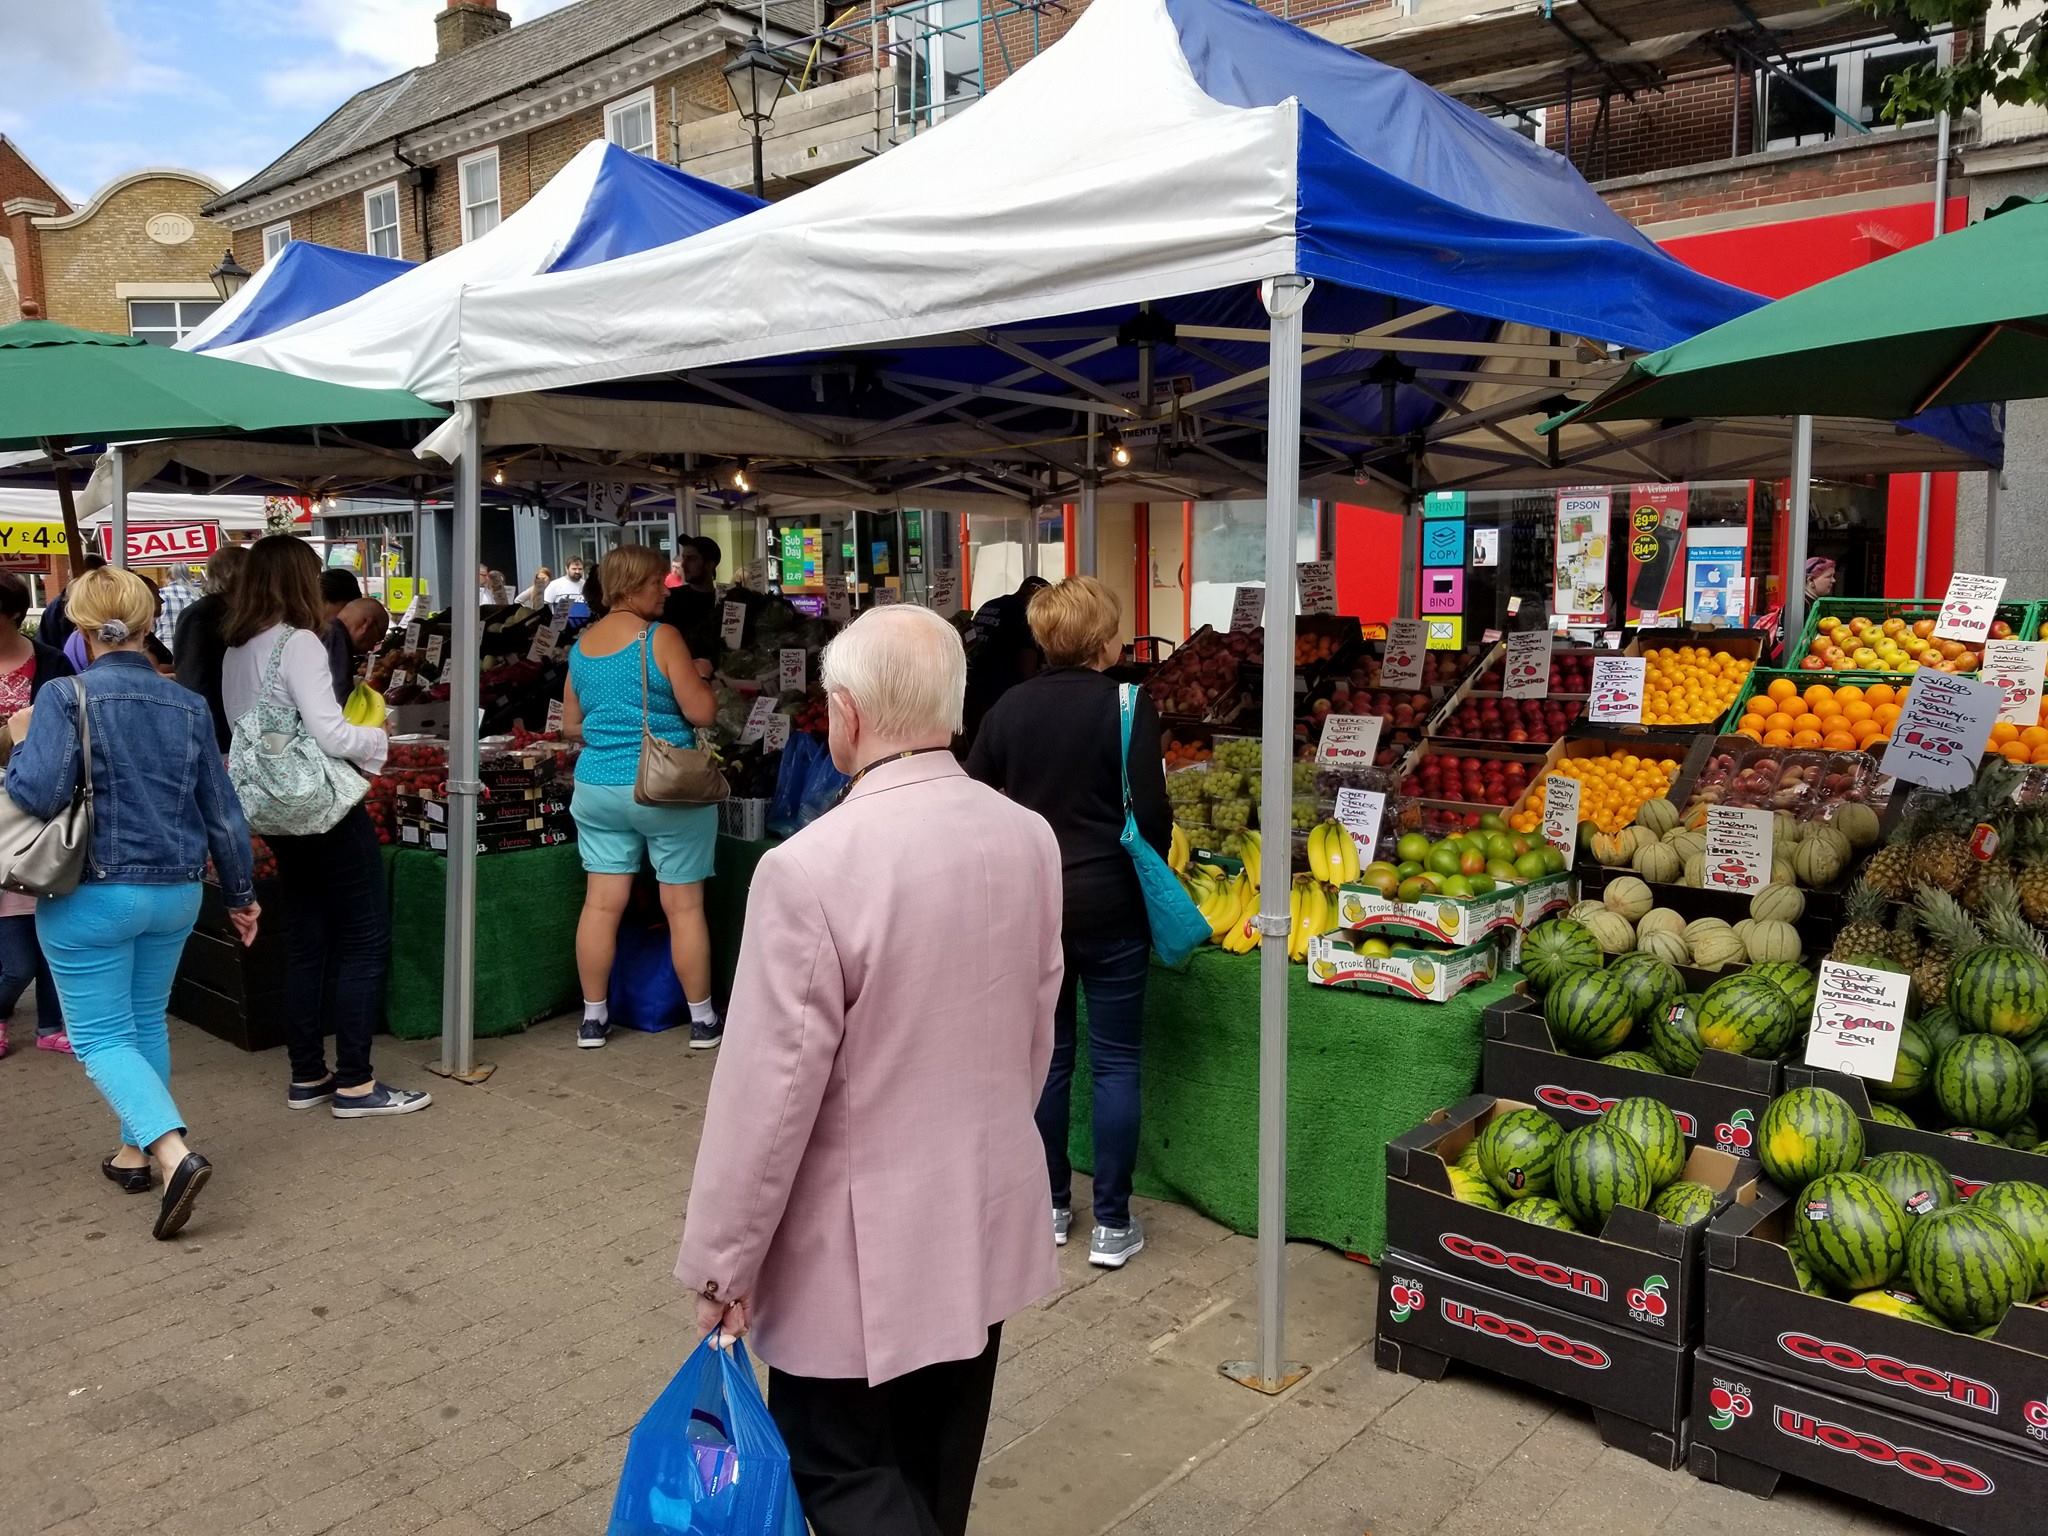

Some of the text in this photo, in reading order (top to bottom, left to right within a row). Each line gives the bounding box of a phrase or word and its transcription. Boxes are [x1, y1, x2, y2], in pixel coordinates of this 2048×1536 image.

[152, 222, 186, 235] 2001
[1647, 485, 1680, 493] Verbatim
[1428, 501, 1461, 513] PRINT
[1566, 500, 1600, 511] EPSON
[1635, 514, 1658, 527] £9.99
[21, 526, 67, 548] £4.0
[127, 529, 202, 557] SALE
[785, 535, 800, 546] Sub
[785, 546, 801, 559] Day
[1429, 550, 1458, 560] COPY
[1429, 597, 1455, 608] BIND
[496, 807, 530, 817] cherries
[1368, 904, 1391, 913] Tropic
[1408, 906, 1427, 918] Fruit
[1339, 960, 1363, 969] Tropic
[1381, 963, 1400, 974] Fruit
[1822, 989, 1896, 1008] WATERMELON
[1838, 1031, 1875, 1045] EACH
[1716, 1142, 1750, 1158] aguilas
[1628, 1308, 1665, 1327] aguilas
[1712, 1377, 1751, 1397] aguilas
